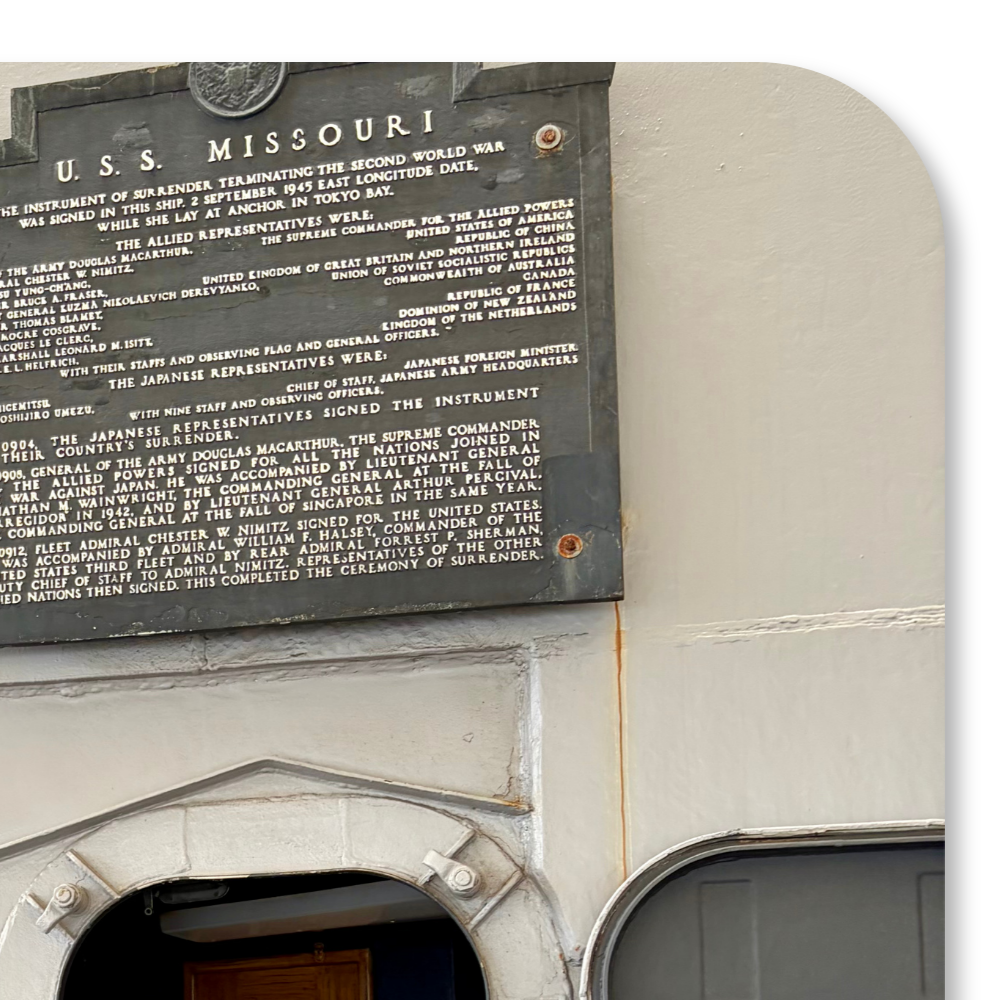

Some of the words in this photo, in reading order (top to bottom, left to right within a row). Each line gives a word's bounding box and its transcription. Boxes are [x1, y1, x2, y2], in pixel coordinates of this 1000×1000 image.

[55, 158, 79, 182] U.
[99, 154, 120, 176] S.
[140, 149, 162, 171] S.
[207, 109, 432, 162] MISSOURI
[18, 216, 45, 229] WAS
[49, 210, 95, 225] SIGNED
[100, 206, 115, 218] IN
[121, 202, 150, 215] THIS
[190, 196, 199, 206] 2
[203, 186, 277, 205] SEPTEMBER
[283, 180, 313, 195] 1945
[317, 175, 350, 190] EAST
[355, 165, 434, 185] LONGITUDE
[23, 193, 106, 214] INSTRUMENT
[110, 190, 128, 202] OF
[132, 180, 213, 199] SURRENDER
[218, 165, 314, 188] TERMINATING
[316, 161, 345, 175] THE
[350, 154, 406, 171] SECOND
[411, 145, 466, 162] WORLD
[472, 140, 505, 154] WAR
[96, 217, 140, 232] WHILE
[145, 214, 169, 226] SHE
[174, 210, 199, 223] LAY
[204, 207, 221, 219] AT
[227, 199, 286, 216] ANCHOR
[291, 196, 308, 208] IN
[312, 189, 360, 205] TOKYO
[115, 238, 142, 251] THE
[147, 231, 194, 247] ALLIED
[198, 215, 322, 240] REPRESENTATIVES
[446, 286, 503, 301] REPUBLIC
[506, 284, 522, 294] OF
[526, 278, 576, 292] FRANCE
[522, 267, 575, 281] CANADA
[50, 434, 78, 446] THE
[89, 425, 161, 442] JAPANESE
[172, 409, 312, 434] REPRESENTATIVES
[323, 402, 380, 418] SIGNED
[391, 397, 423, 411] THE
[435, 386, 539, 407] INSTRUMENT
[0, 448, 45, 463] THEIR
[55, 439, 134, 458] COUNTRY'S
[145, 430, 239, 448] SURRENDER.
[27, 588, 82, 602] NATIONS
[85, 584, 123, 597] THEN
[129, 580, 179, 594] SIGNED.
[185, 577, 215, 589] THIS
[221, 569, 299, 586] COMPLETED
[306, 566, 333, 578] THE
[340, 558, 419, 575] CEREMONY
[426, 556, 444, 568] OF
[450, 549, 544, 566] SURRENDER.
